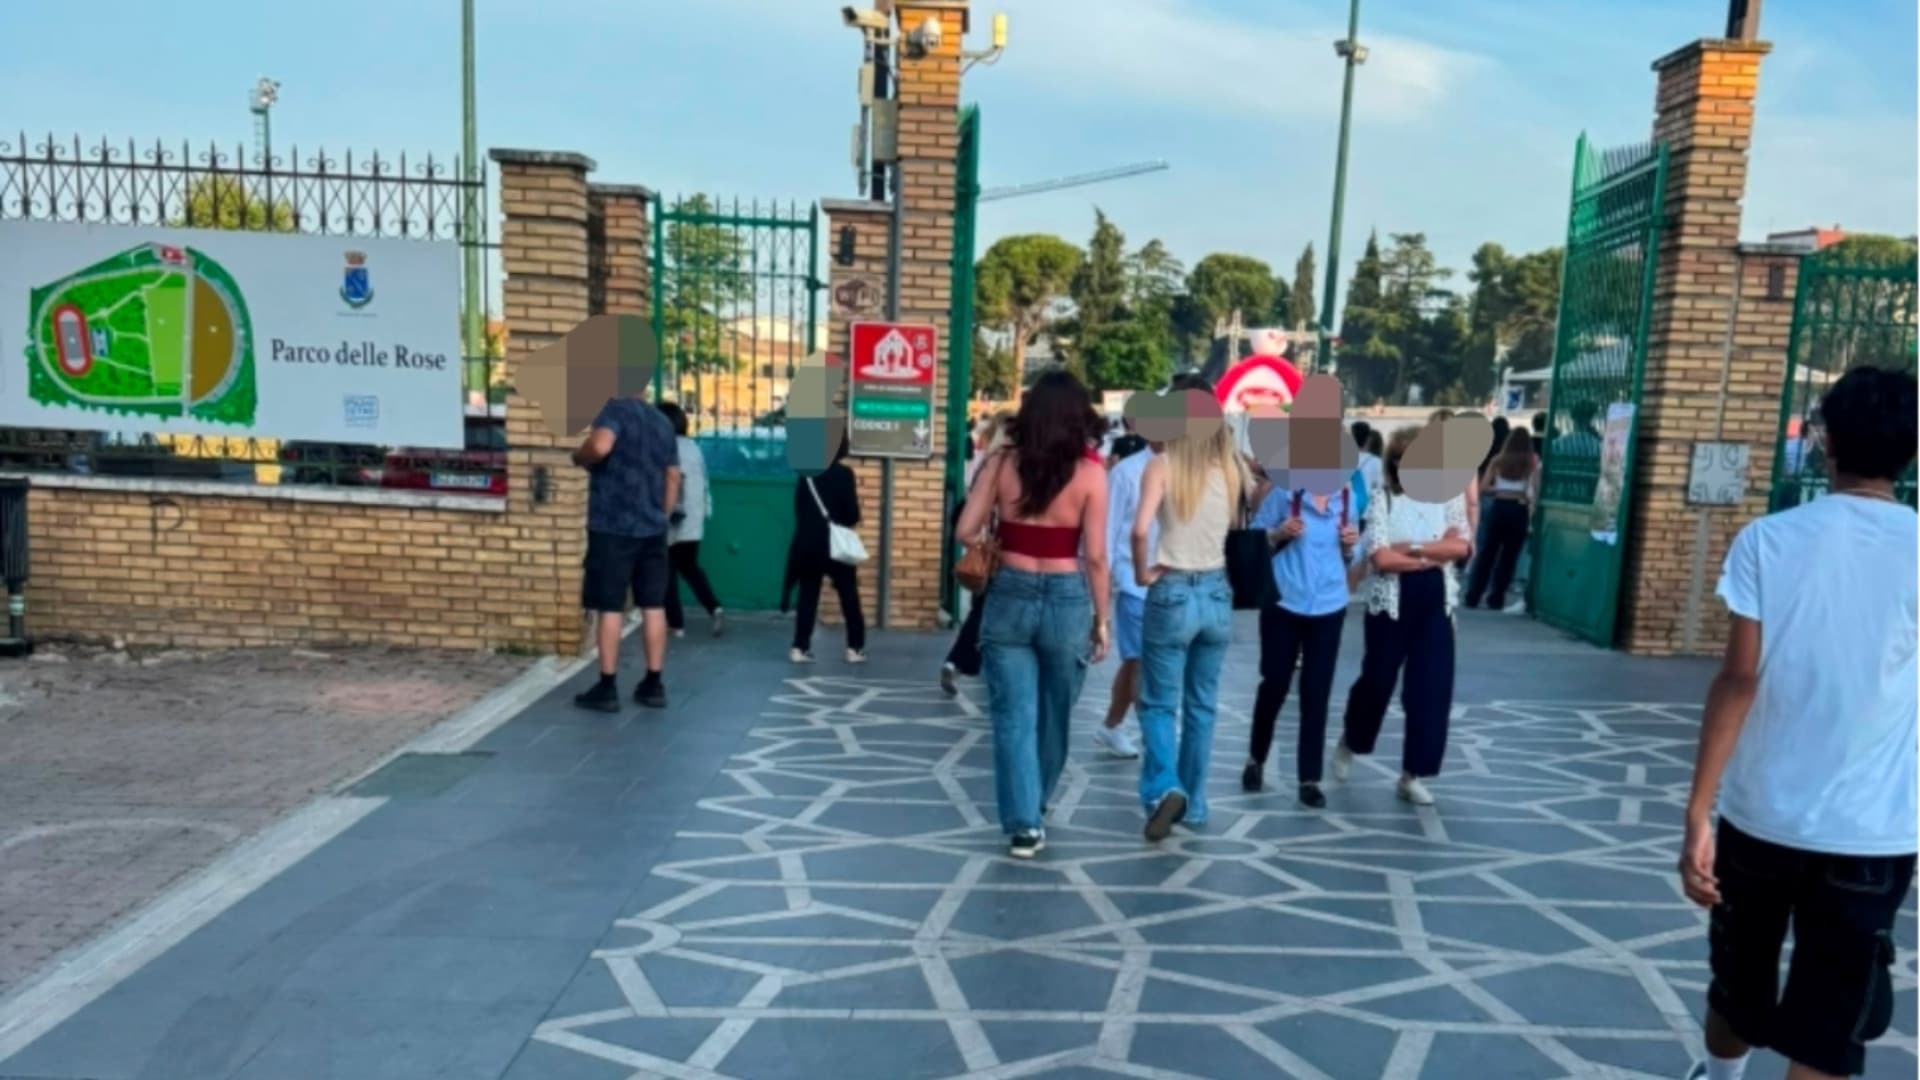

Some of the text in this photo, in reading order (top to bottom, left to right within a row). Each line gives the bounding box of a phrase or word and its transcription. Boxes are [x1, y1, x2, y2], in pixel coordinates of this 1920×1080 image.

[271, 338, 447, 371] Parco delle Rose
